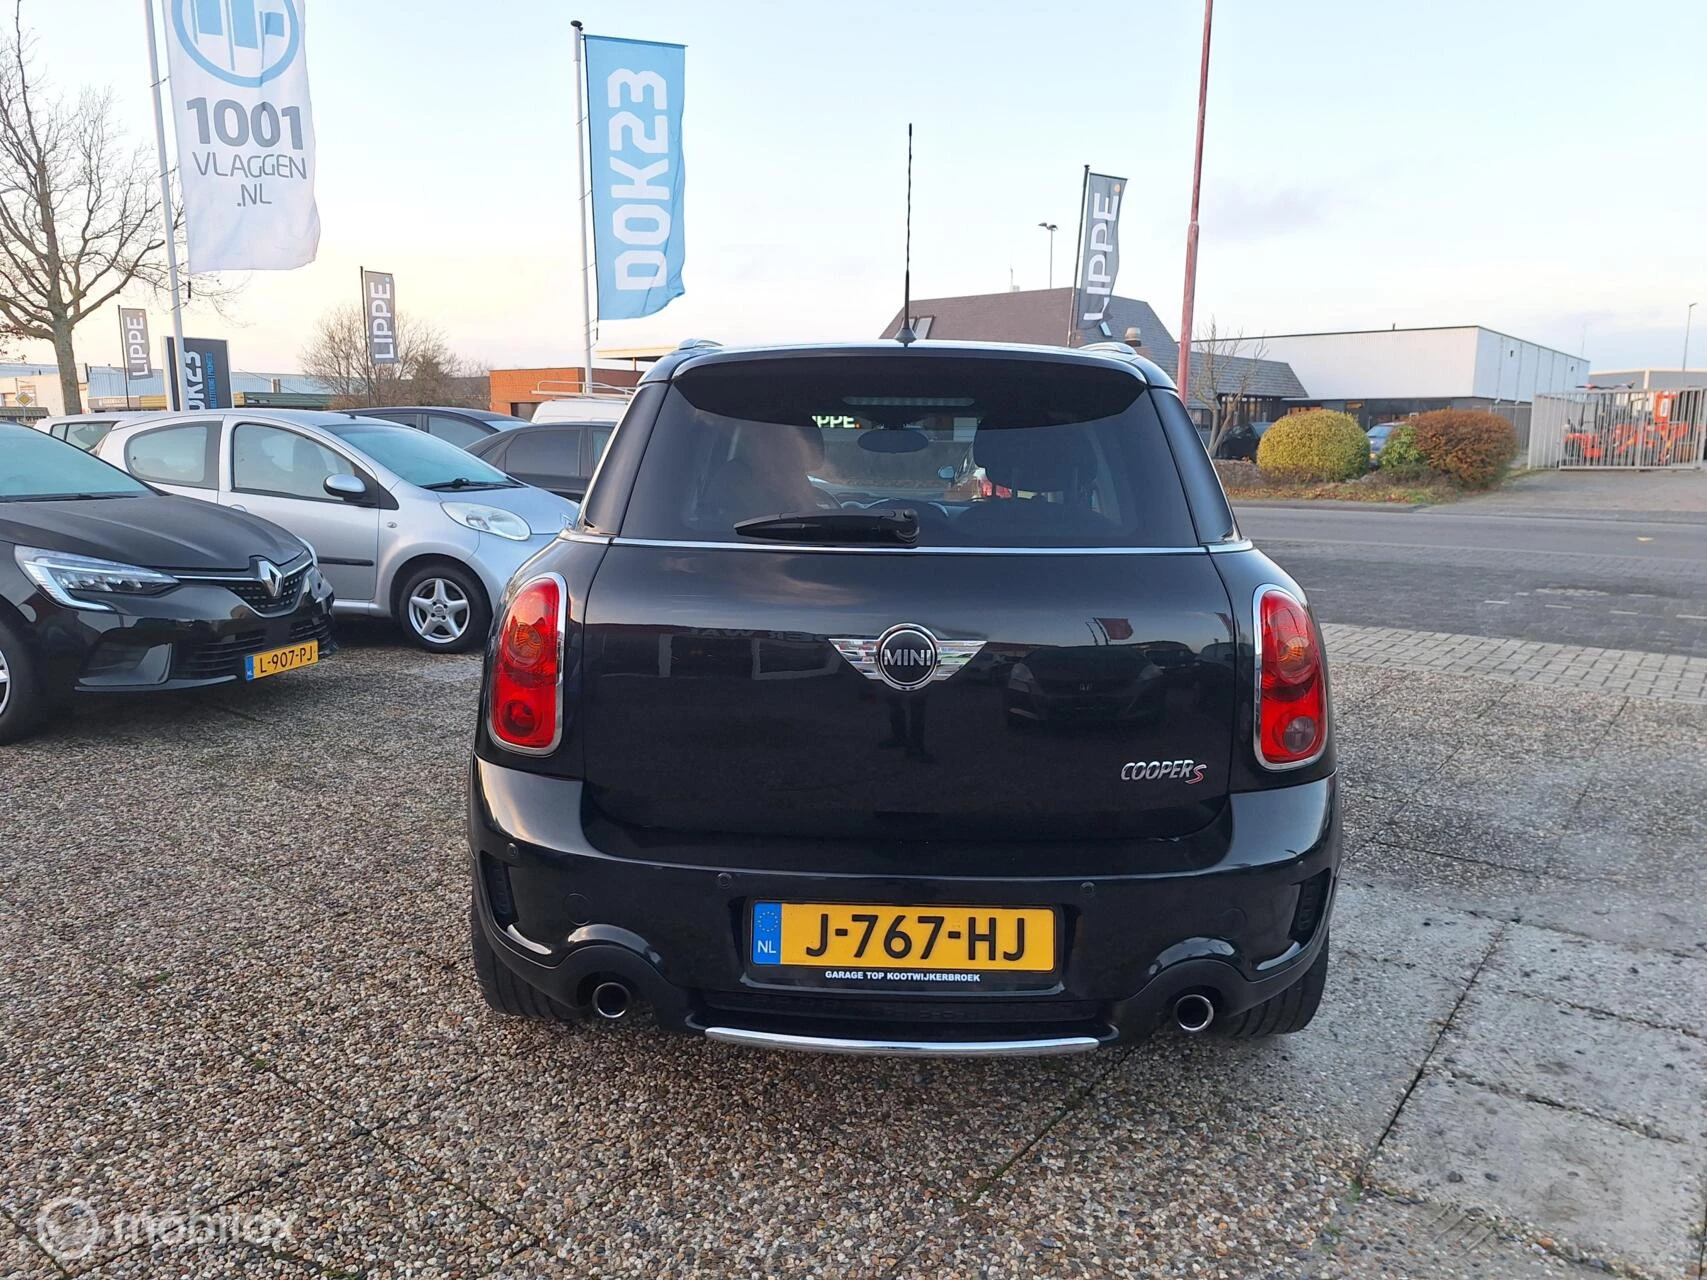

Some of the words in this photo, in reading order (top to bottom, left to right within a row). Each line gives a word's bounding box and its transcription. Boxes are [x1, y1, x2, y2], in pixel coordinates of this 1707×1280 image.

[186, 97, 305, 150] 1001
[192, 151, 308, 180] VLAGGEN
[607, 67, 672, 291] DOK23
[236, 183, 273, 208] .NL
[1083, 183, 1121, 321] LIPPE.
[369, 277, 395, 359] LIPPE.
[126, 312, 149, 376] LIPPE.
[811, 415, 861, 428] PPE.
[260, 645, 313, 673] L-907-PJ
[883, 649, 932, 666] MINI
[1120, 759, 1195, 780] COOPER
[757, 940, 777, 954] NL
[805, 913, 1026, 962] J-767-HJ
[825, 970, 864, 980] GARAGE
[865, 971, 885, 980] TOP
[886, 971, 981, 982] KOOTWIJKERBROEK
